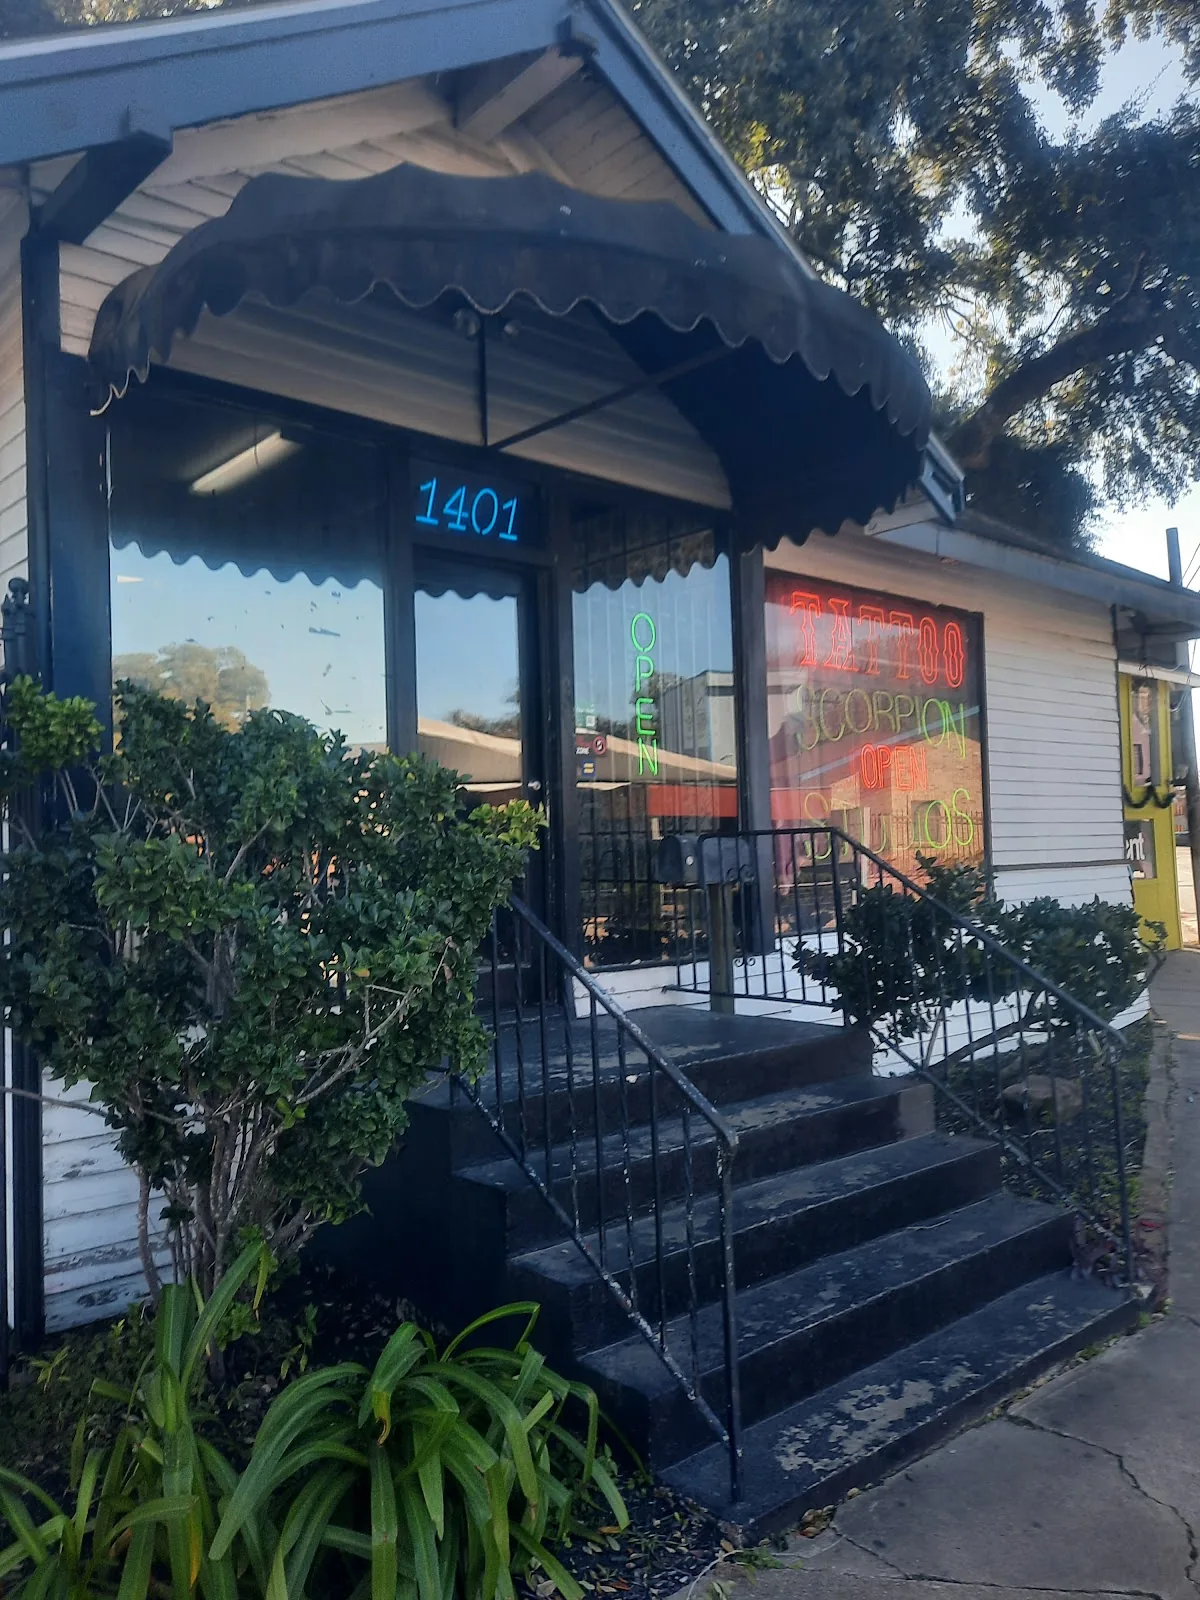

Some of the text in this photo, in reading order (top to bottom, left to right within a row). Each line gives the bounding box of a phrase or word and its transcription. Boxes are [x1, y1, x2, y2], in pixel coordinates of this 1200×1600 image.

[415, 477, 518, 541] 1401
[790, 591, 964, 688] TATTOO
[631, 612, 658, 776] OPEN
[795, 684, 966, 760] SCORPION
[861, 744, 927, 791] OPEN
